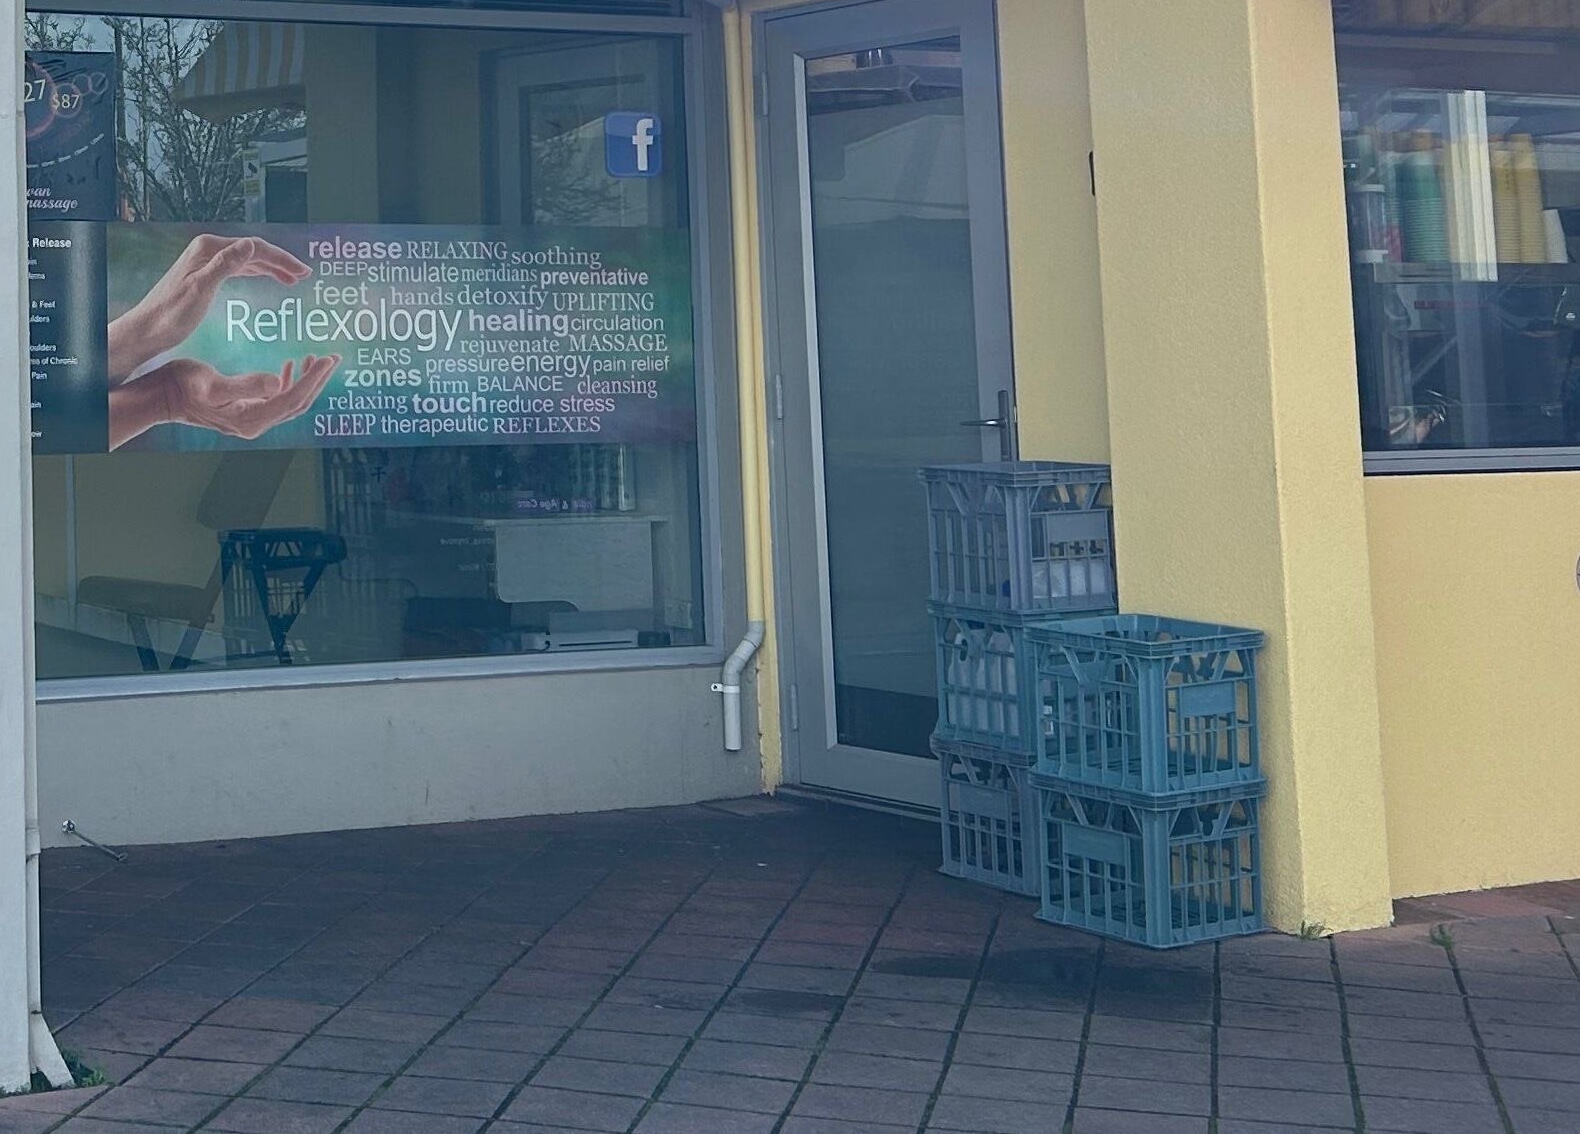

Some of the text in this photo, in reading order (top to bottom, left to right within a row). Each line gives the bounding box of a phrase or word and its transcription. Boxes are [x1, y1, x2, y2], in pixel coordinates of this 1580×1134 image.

[32, 237, 72, 248] Release
[309, 235, 602, 270] release RELAXING soothing
[319, 261, 649, 289] DEEP stimulate meridians preventative
[313, 280, 655, 312] feet hands detoxify UPLIFTING
[226, 297, 664, 352] Reflexology healing circulation
[460, 334, 668, 358] rejuvenate MASSAGE
[357, 347, 670, 378] EARS pressure energy pain relief
[344, 369, 658, 399] zones firm BALANCE cleansing
[329, 390, 616, 414] relaxing touch reduce stress
[314, 414, 601, 437] SLEEP therapeutic REFLEXES
